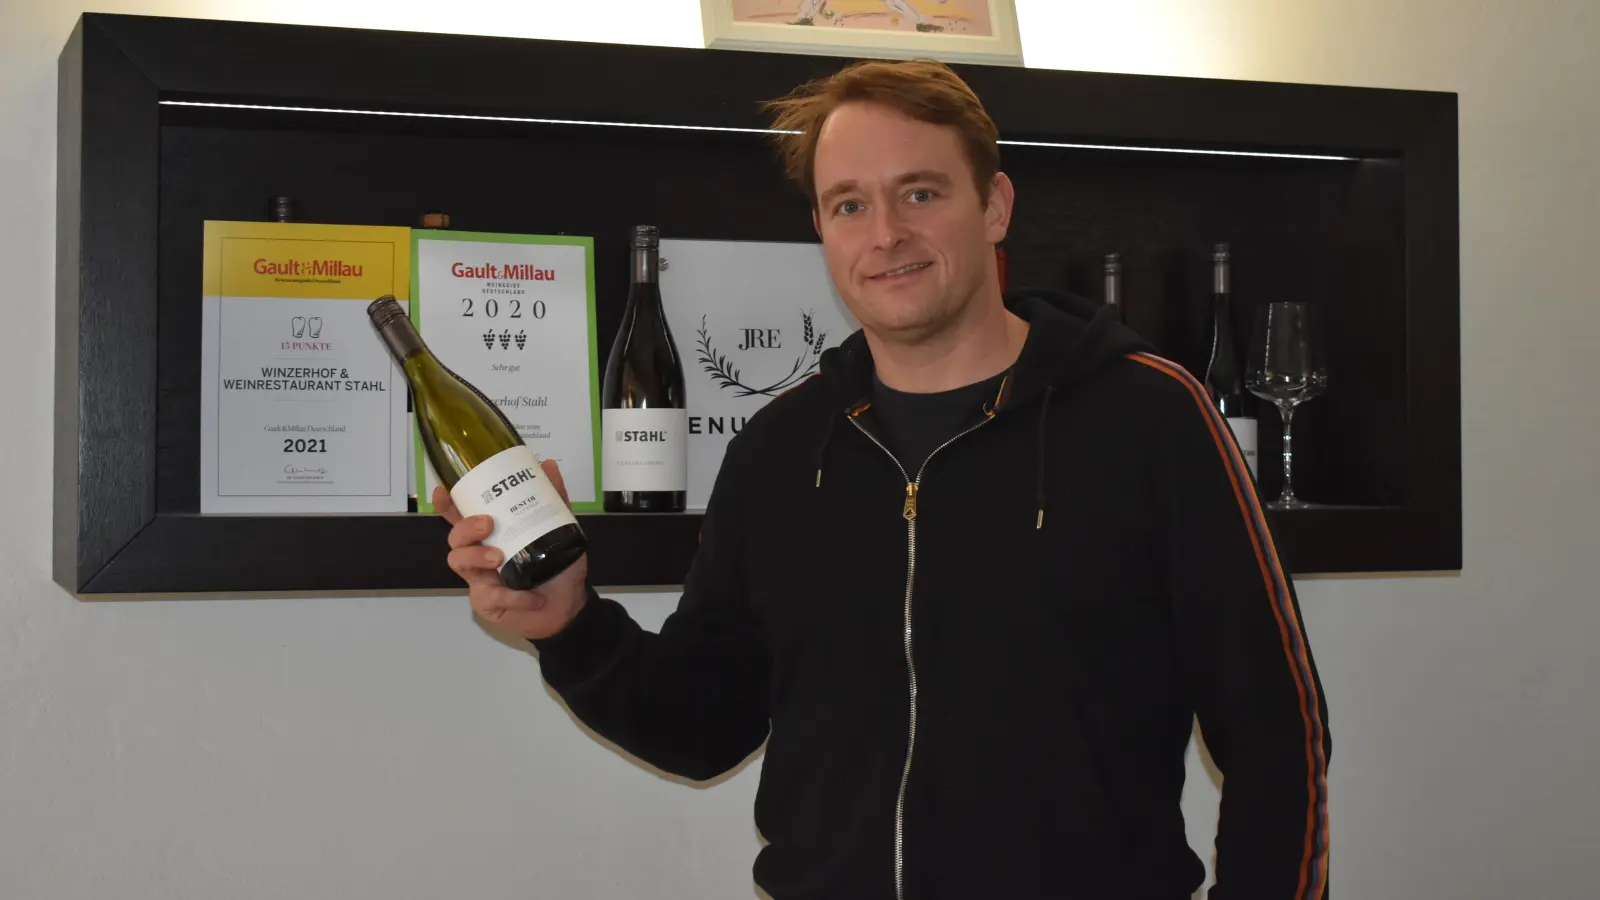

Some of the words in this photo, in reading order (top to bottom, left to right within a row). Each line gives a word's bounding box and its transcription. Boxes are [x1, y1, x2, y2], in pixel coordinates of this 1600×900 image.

[451, 262, 555, 281] Gault&Millau
[738, 328, 782, 351] JRE
[292, 341, 332, 351] PUNKTE
[261, 367, 337, 378] WINZERHOF
[340, 368, 349, 379] &
[508, 364, 521, 373] gut
[223, 379, 341, 391] WEINRESTAURANT
[345, 381, 386, 391] STAHL
[489, 396, 522, 409] erhof
[522, 396, 548, 407] Stahl
[283, 439, 327, 453] 2021
